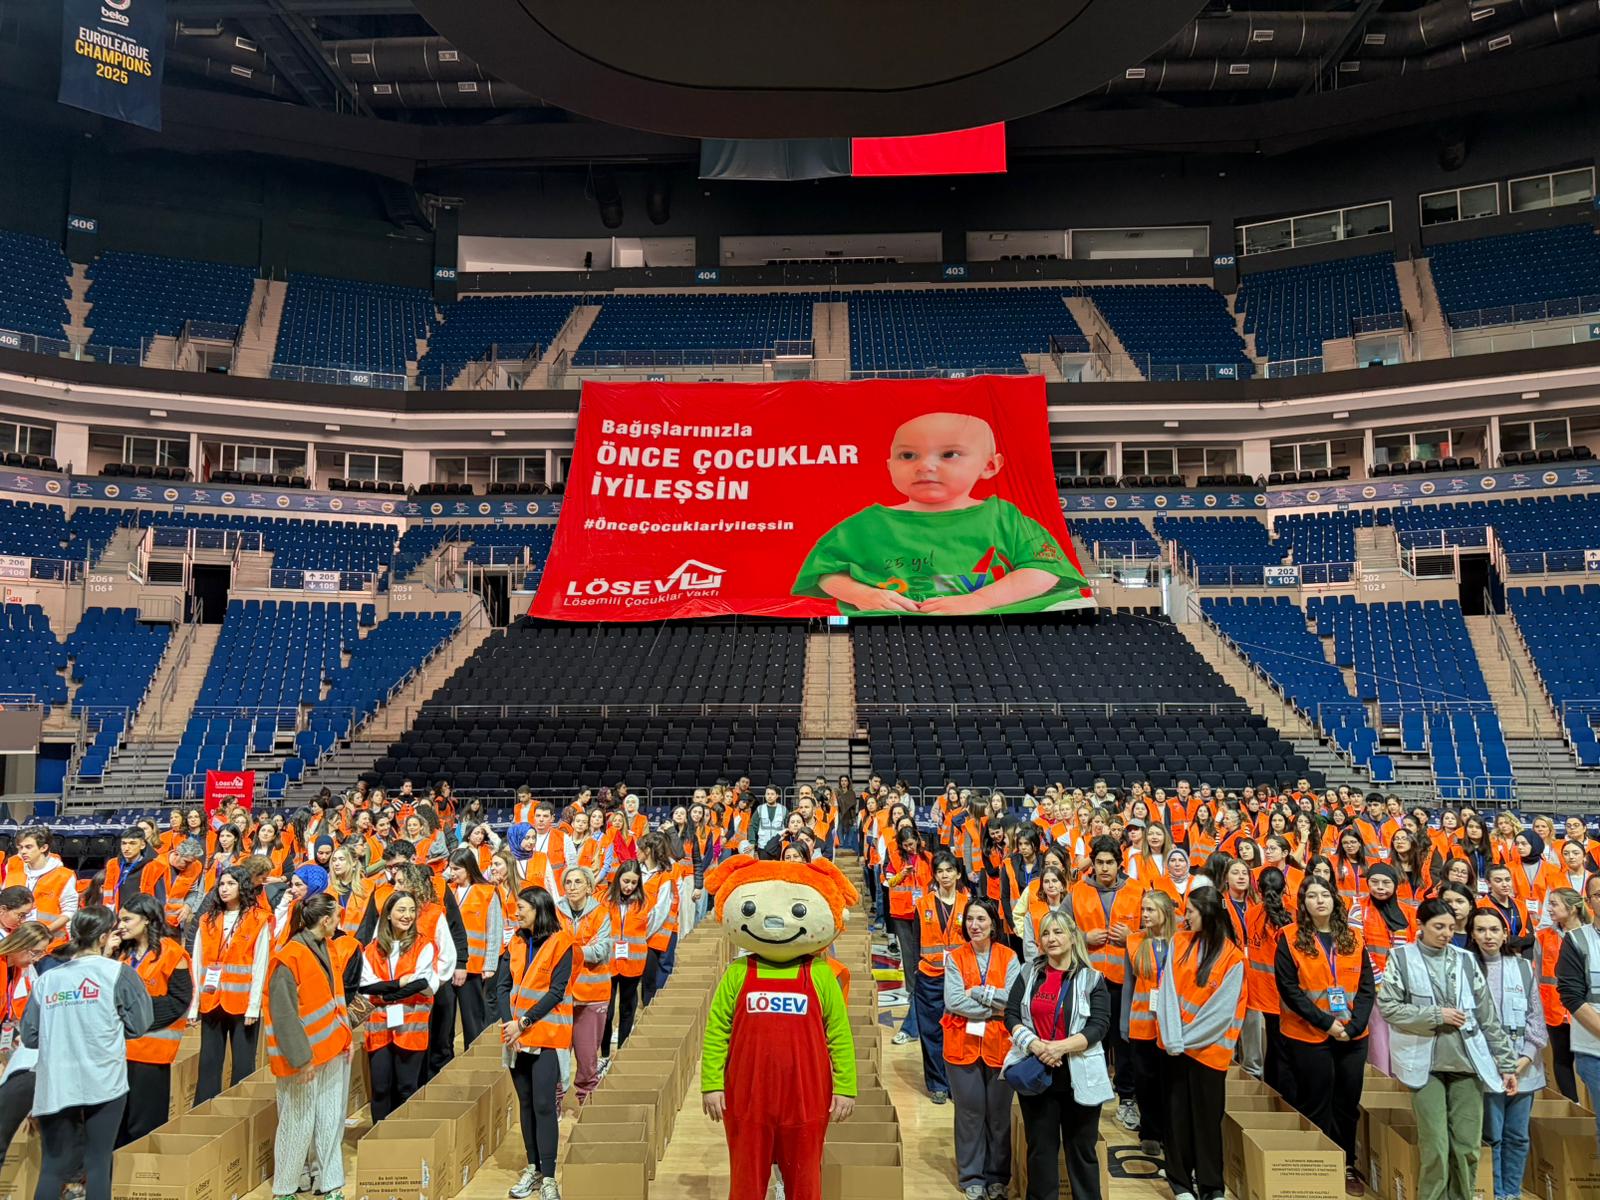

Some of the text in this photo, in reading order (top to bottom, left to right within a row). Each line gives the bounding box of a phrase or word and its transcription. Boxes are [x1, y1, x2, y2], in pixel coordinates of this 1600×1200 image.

[101, 6, 129, 24] beko
[79, 26, 150, 61] EUROLEAGUE
[75, 39, 152, 76] CHAMPIONS
[96, 63, 129, 85] 2025
[71, 219, 94, 230] 406
[1214, 256, 1234, 265] 402
[436, 269, 455, 278] 405
[698, 272, 717, 280] 404
[945, 267, 965, 275] 403
[0, 335, 18, 346] 406
[353, 374, 369, 383] 405
[601, 419, 753, 439] Bağışlarınızla
[597, 441, 859, 475] ÖNCE ÇOCUKLAR
[591, 471, 749, 504] İYİLEŞSİN
[90, 575, 108, 583] 206
[566, 577, 677, 596] LÖSEV
[563, 597, 621, 606] Lösemili
[625, 592, 682, 607] Çocuklar
[748, 993, 807, 1013] LÖSEV
